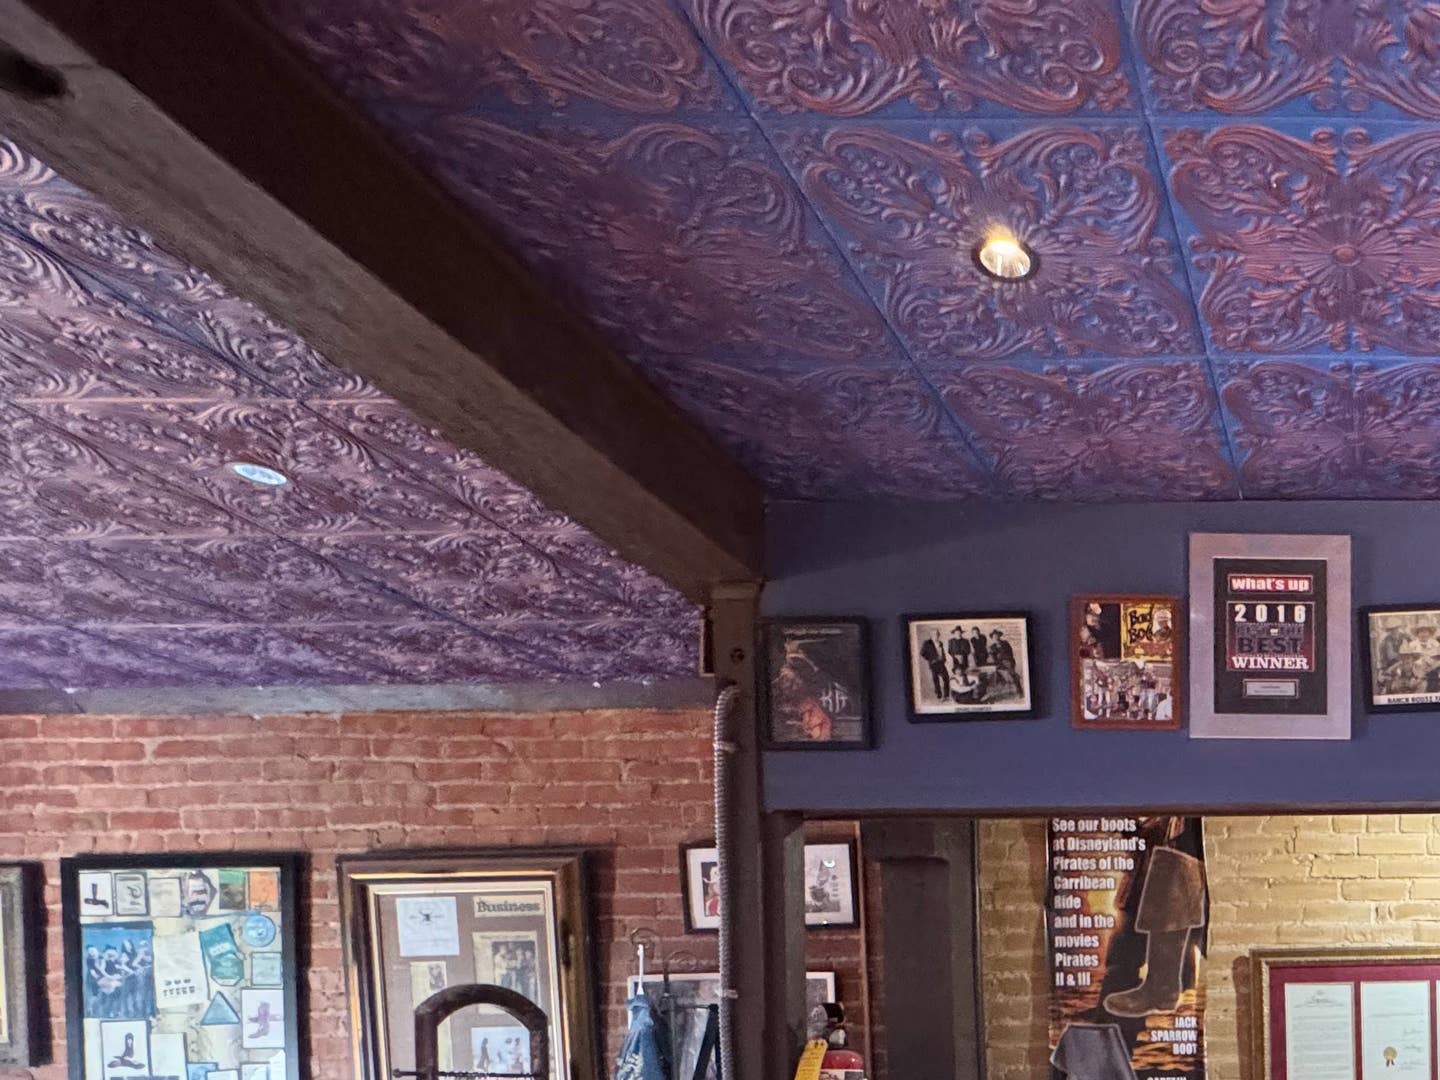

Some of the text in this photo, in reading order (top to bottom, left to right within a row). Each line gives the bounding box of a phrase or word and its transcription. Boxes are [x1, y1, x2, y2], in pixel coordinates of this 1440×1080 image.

[1231, 577, 1310, 592] what's up
[1237, 637, 1301, 653] BEST
[1231, 656, 1310, 670] WINNER
[1052, 817, 1137, 832] See our boots
[1053, 836, 1146, 852] at Disneyland's
[1053, 856, 1135, 870] Pirates of the
[1054, 876, 1115, 890] Carribean
[477, 900, 540, 912] Business
[1054, 895, 1082, 909] Ride
[1054, 914, 1115, 928] and in the
[1055, 934, 1099, 948] movies
[1055, 953, 1099, 967] Pirates
[1055, 972, 1091, 986] II & III
[1175, 1016, 1198, 1029] JACK
[1151, 1030, 1198, 1042] SPARROW
[1173, 1043, 1197, 1055] BOOT
